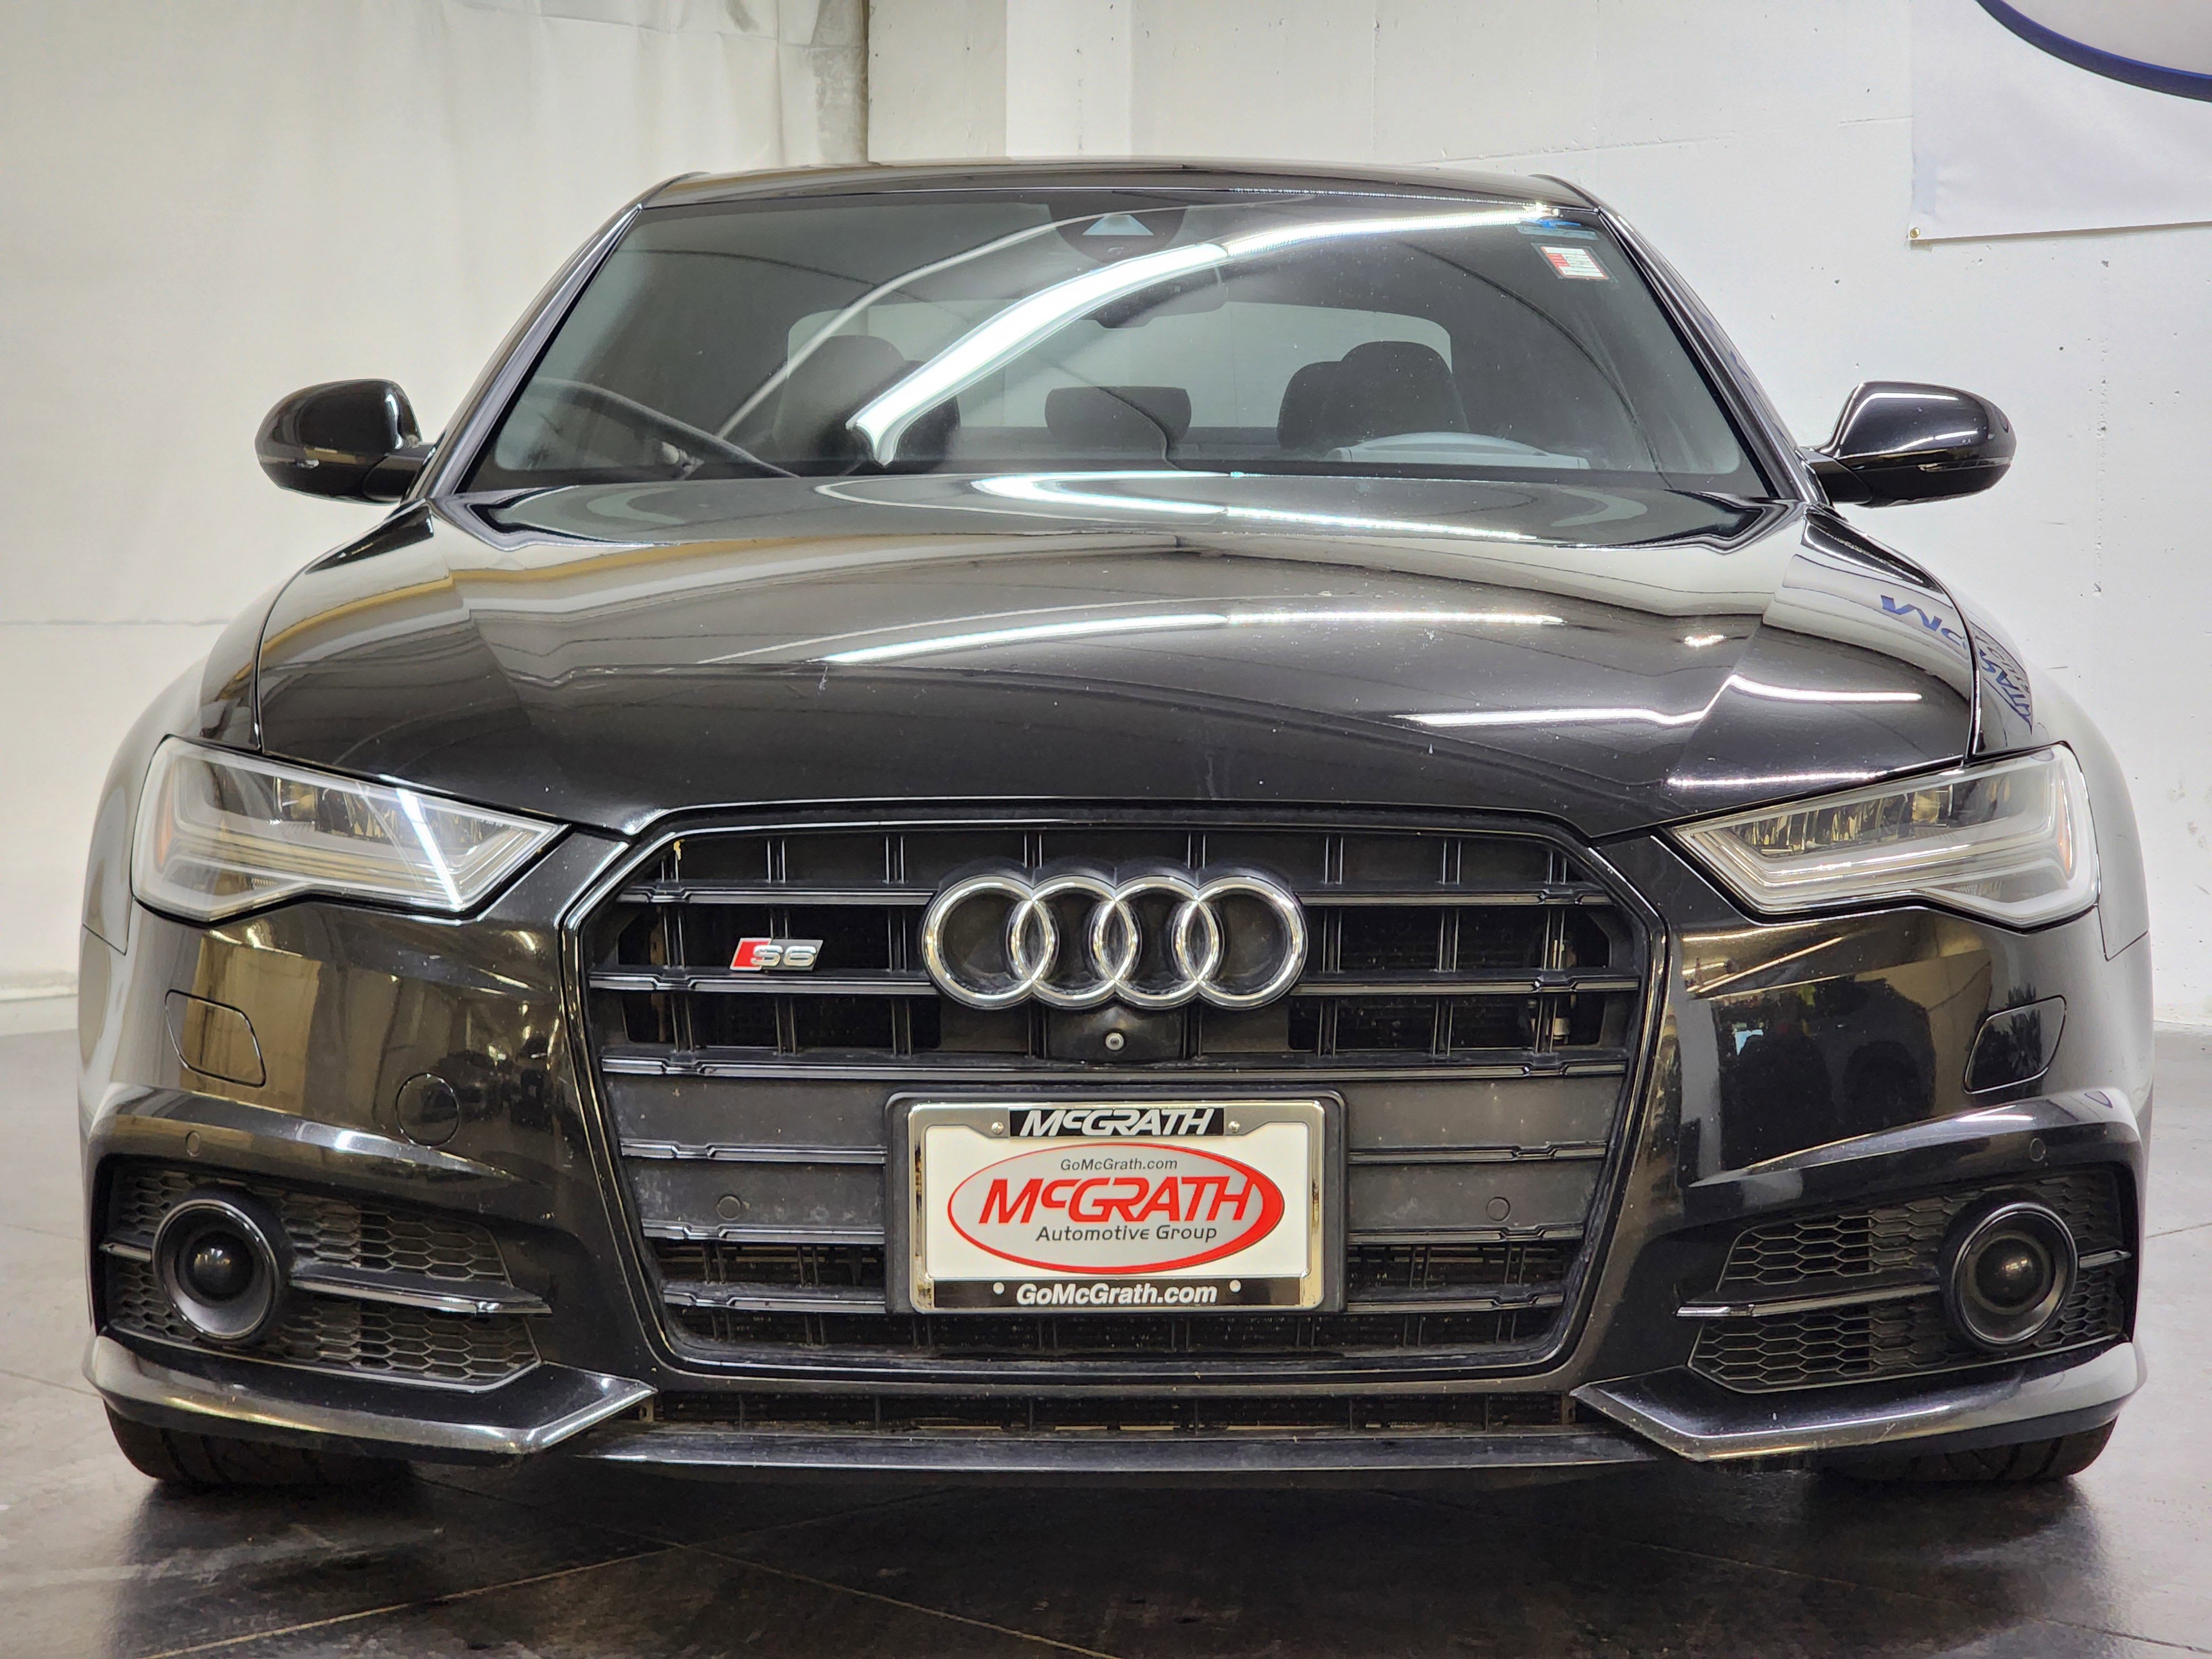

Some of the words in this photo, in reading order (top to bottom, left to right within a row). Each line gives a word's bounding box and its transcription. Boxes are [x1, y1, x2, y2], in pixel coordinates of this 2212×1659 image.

[750, 945, 817, 967] S6
[1060, 1157, 1178, 1171] GoMcGrath.com
[1035, 1225, 1150, 1241] Automotive
[1156, 1224, 1217, 1243] Group
[1016, 1282, 1218, 1306] GoMcGrath.com
